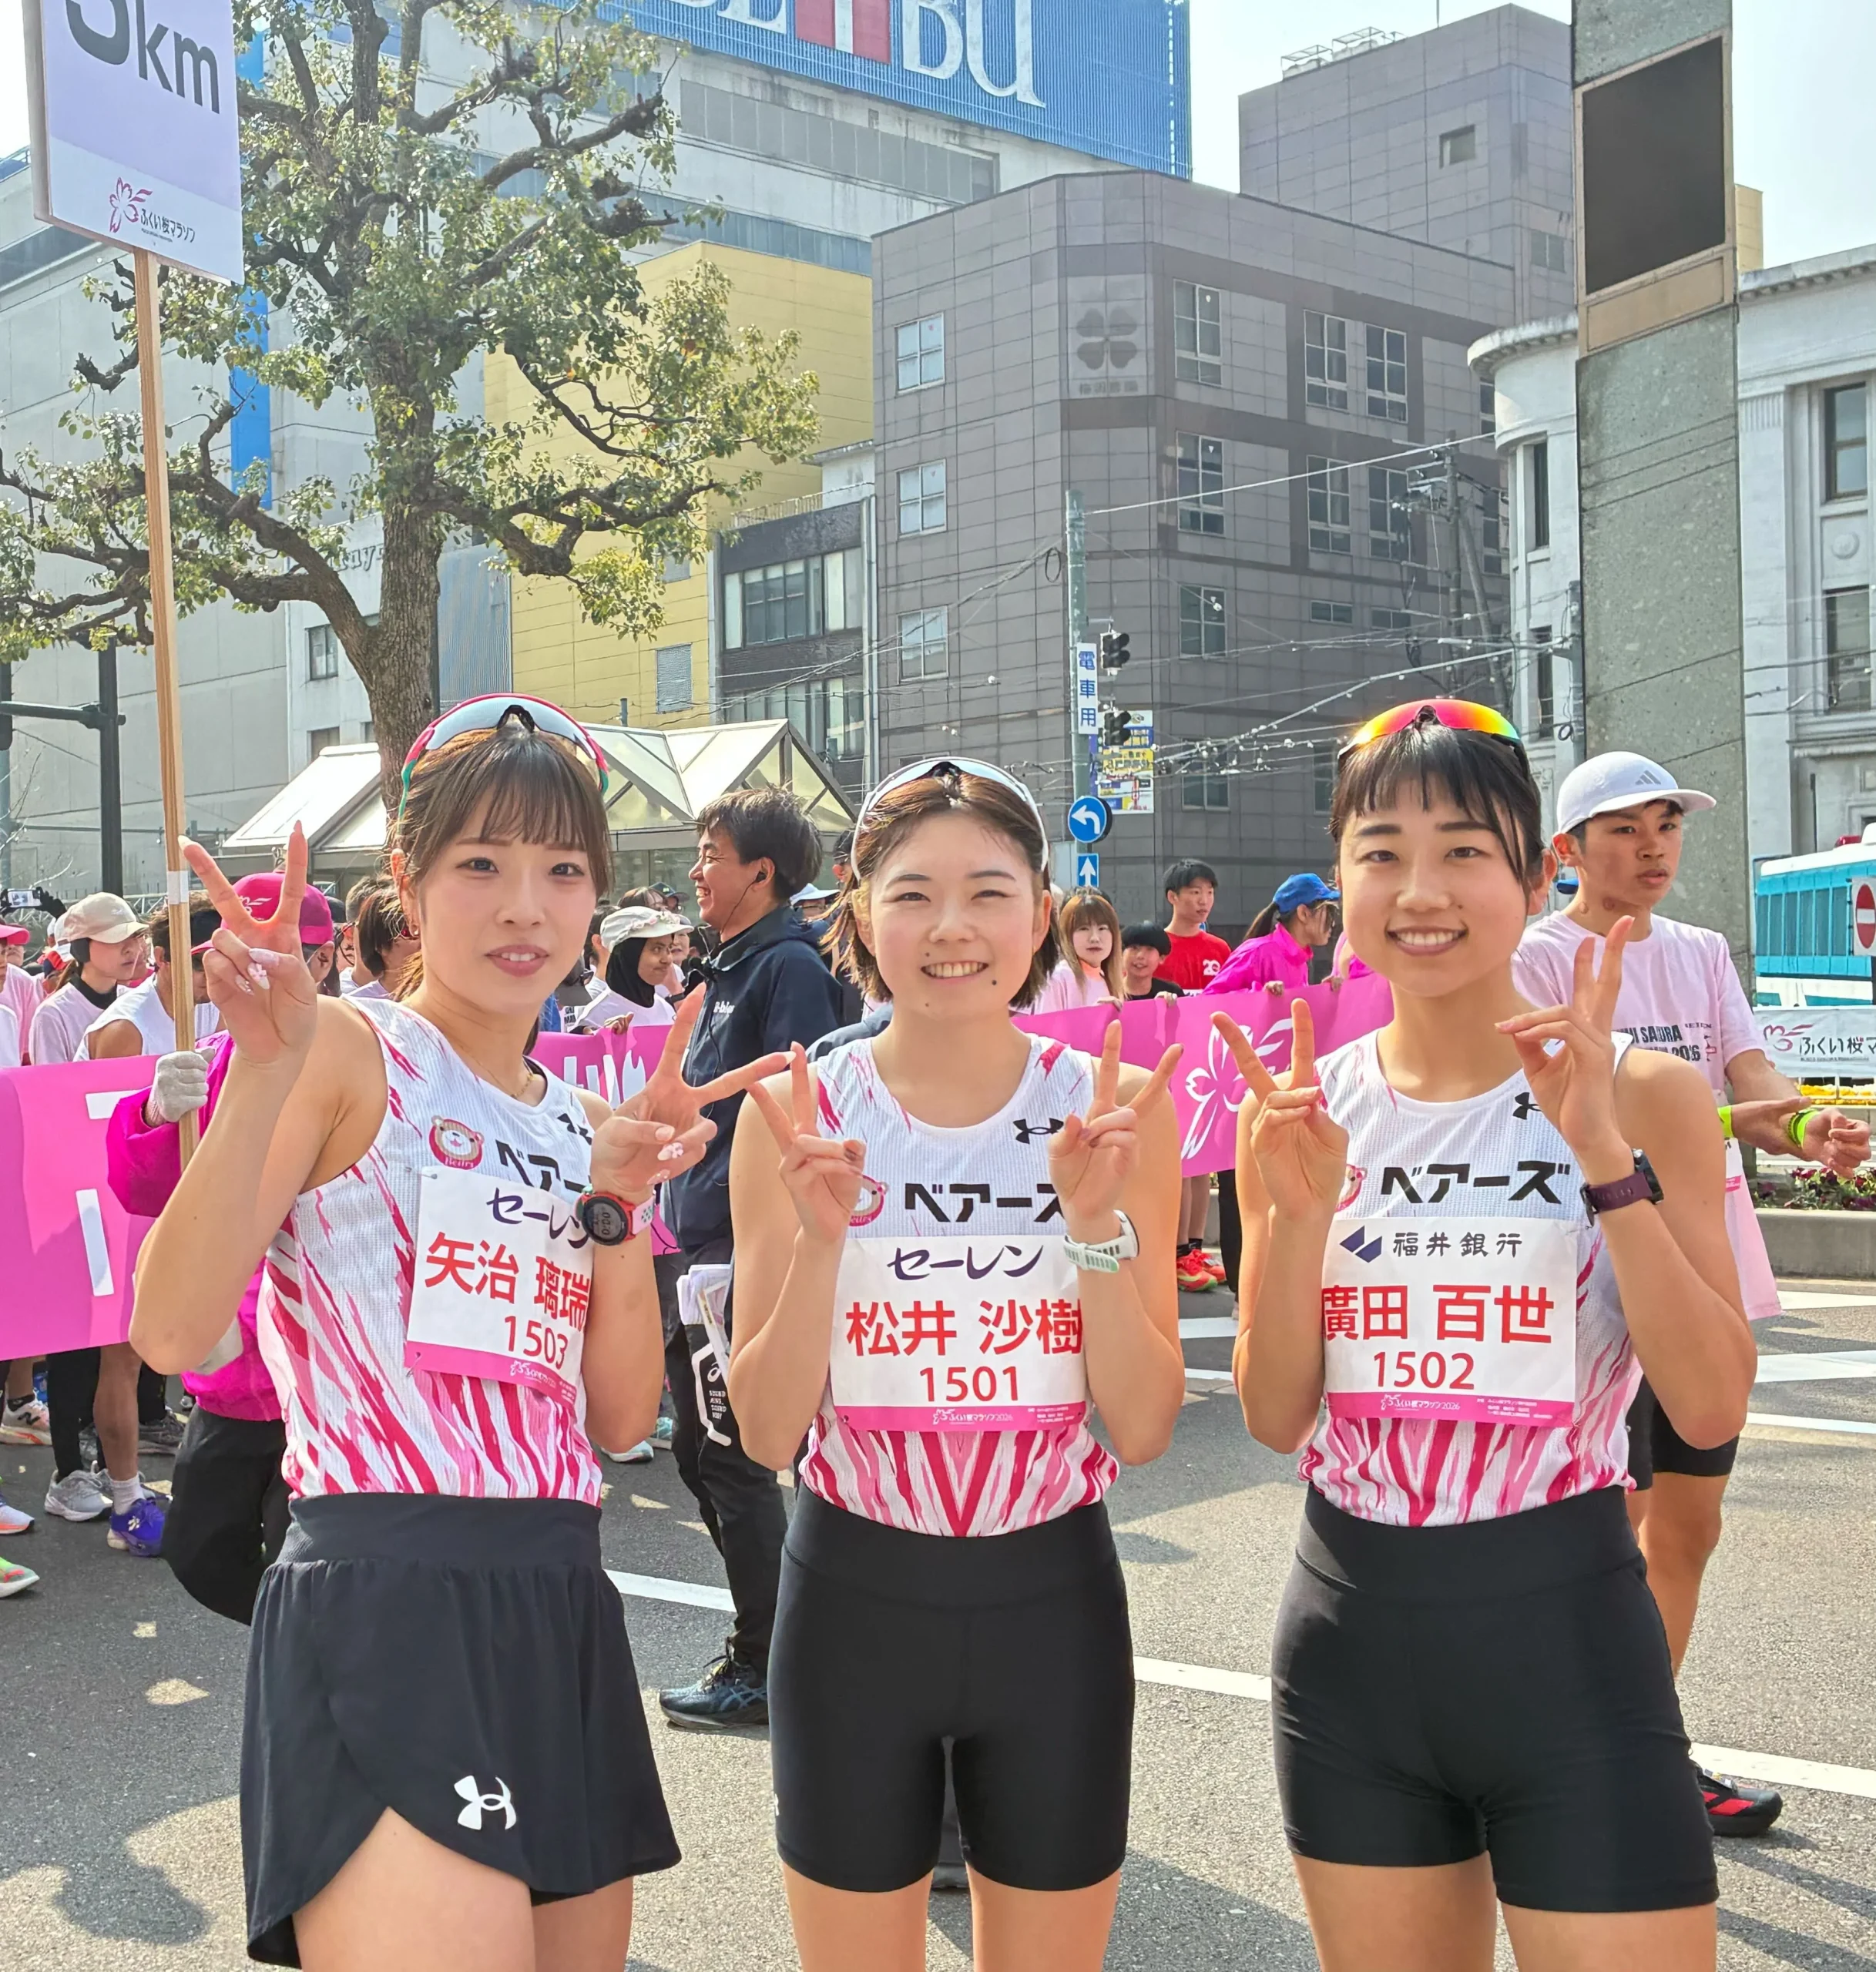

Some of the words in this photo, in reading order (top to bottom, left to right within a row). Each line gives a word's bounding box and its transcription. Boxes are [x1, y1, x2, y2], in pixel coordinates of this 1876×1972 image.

[1079, 651, 1096, 727] 電車用
[495, 1139, 592, 1192] ベアー
[1381, 1160, 1570, 1204] ベアーズ
[486, 1187, 590, 1249] セーレン
[1392, 1231, 1523, 1259] 福井銀行
[425, 1231, 519, 1305] 矢治
[534, 1256, 590, 1332] 璃瑞
[887, 1245, 1044, 1280] セーレン
[845, 1300, 957, 1357] 松井
[978, 1298, 1083, 1355] 沙樹
[1321, 1284, 1408, 1341] 廣田
[1432, 1284, 1555, 1343] 百世
[504, 1315, 569, 1370] 1503
[919, 1366, 1019, 1402] 1501
[1374, 1351, 1475, 1390] 1502
